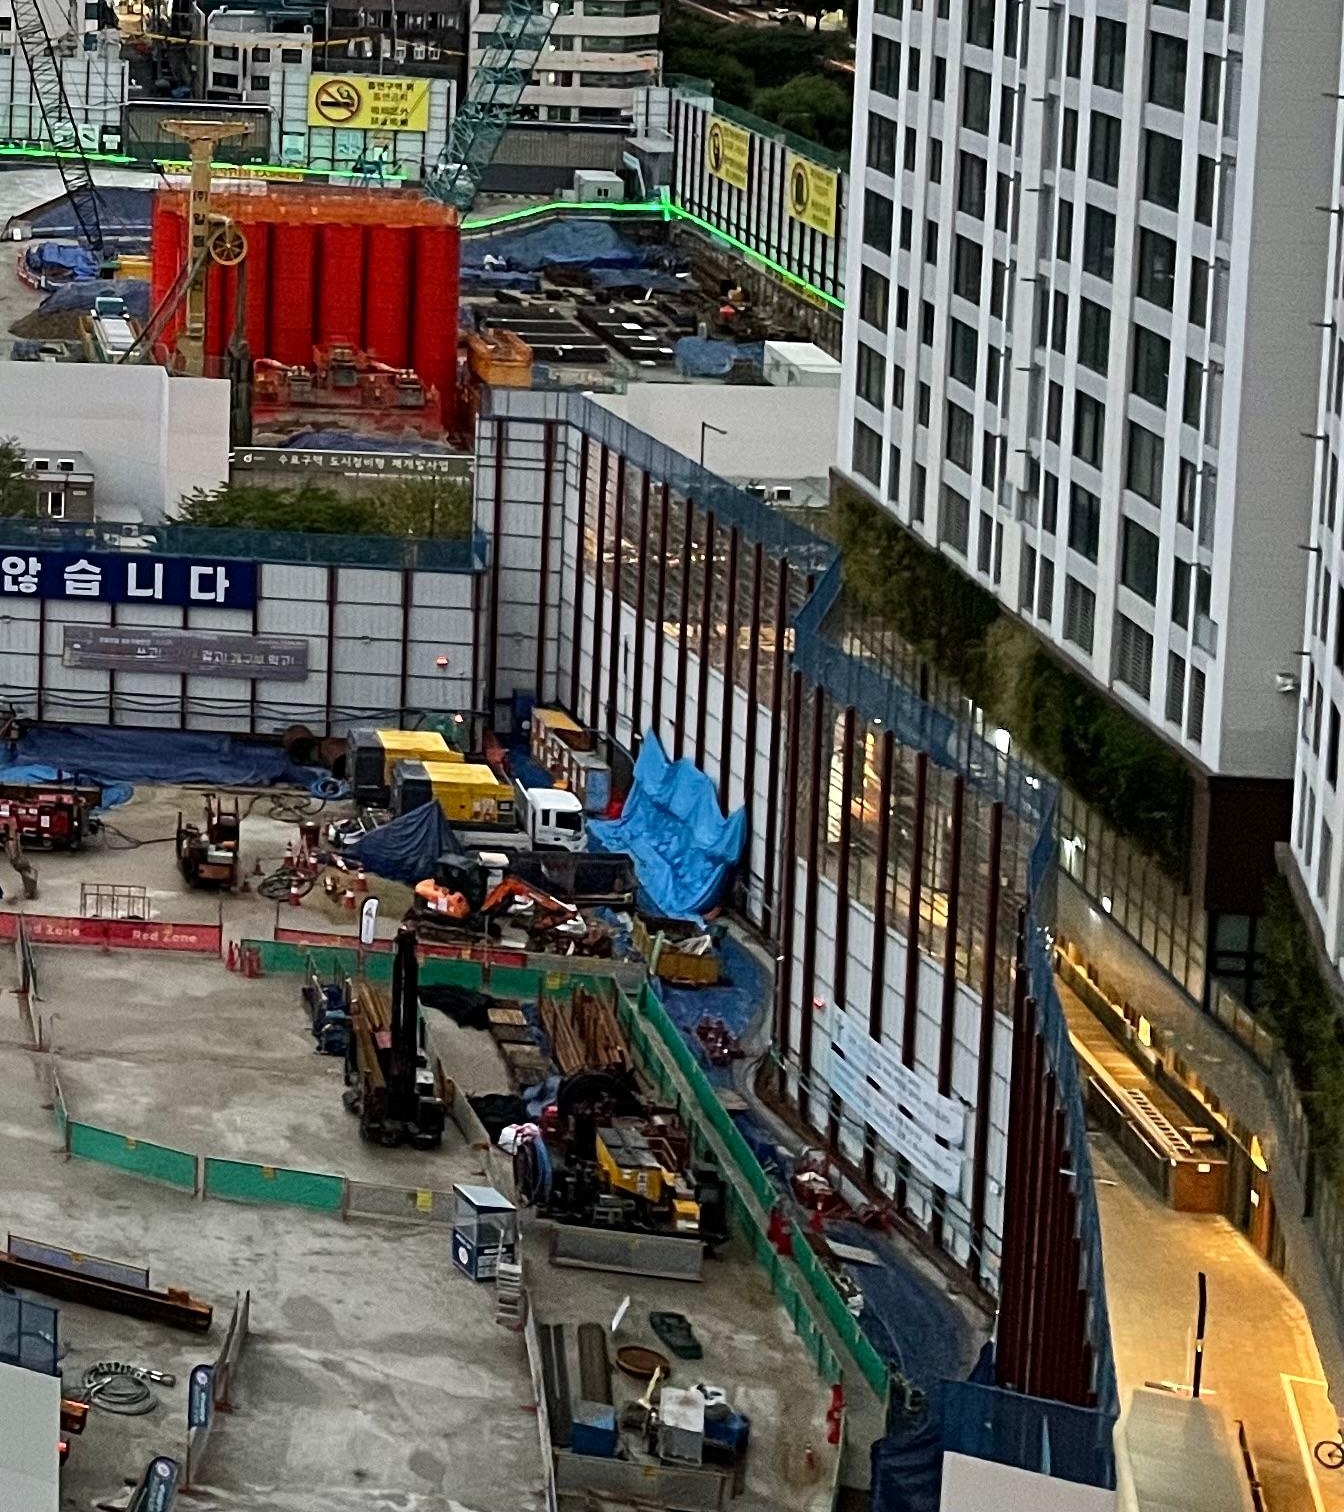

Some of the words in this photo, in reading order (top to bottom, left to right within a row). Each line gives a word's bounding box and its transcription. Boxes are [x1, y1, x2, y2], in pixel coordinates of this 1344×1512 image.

[1, 556, 230, 603] 않습니다
[47, 925, 80, 937] Zone
[132, 929, 159, 942] Red
[162, 932, 198, 944] Zone
